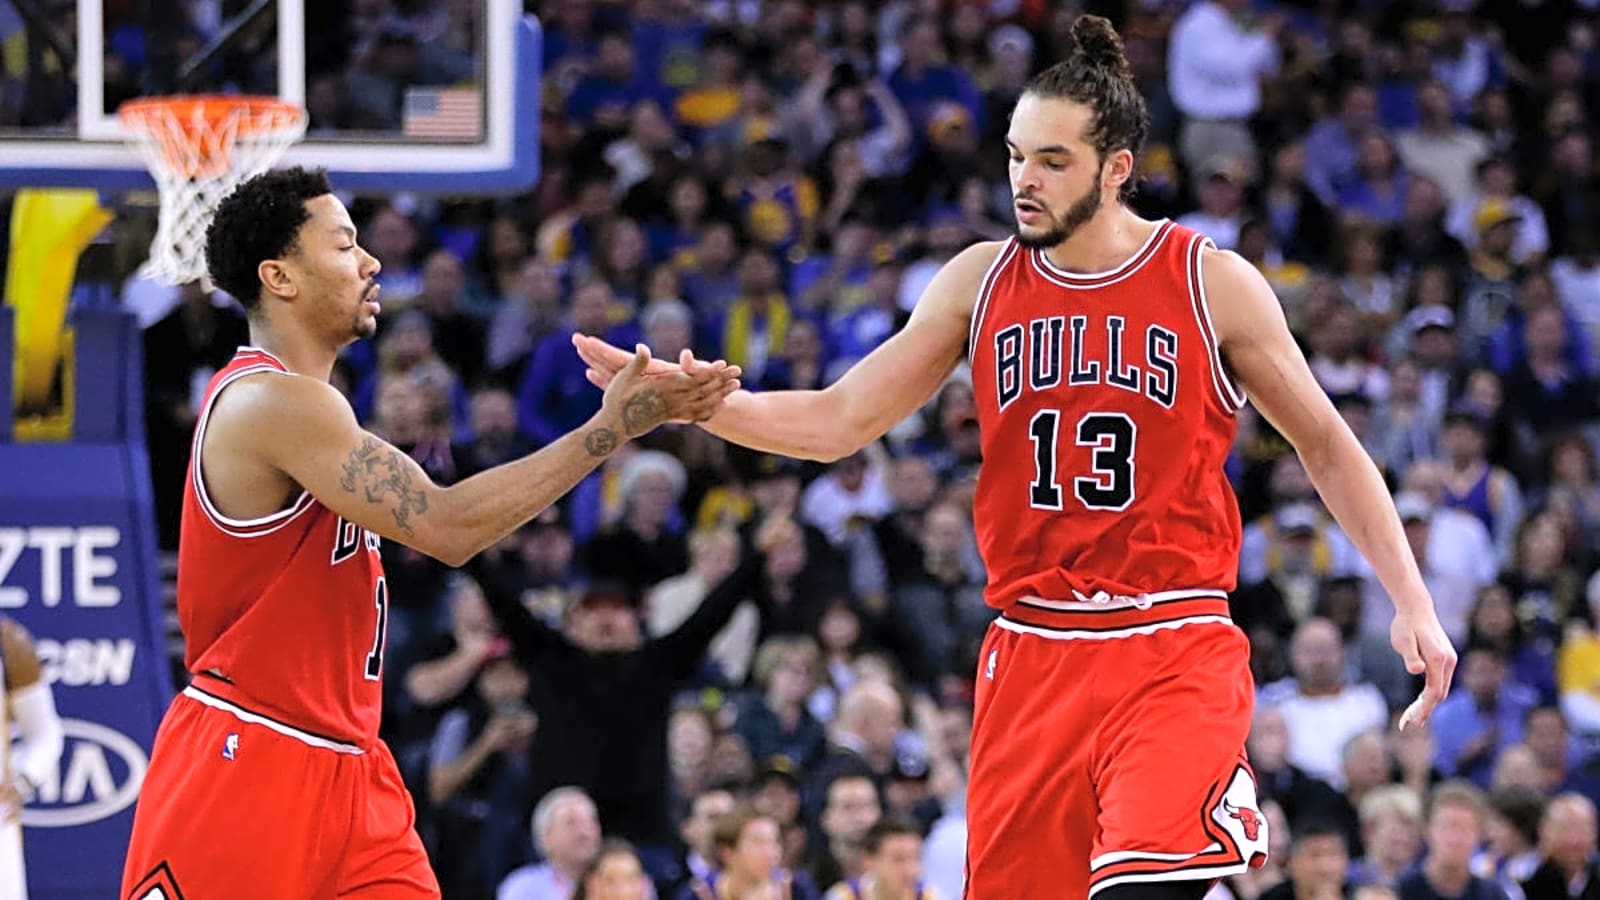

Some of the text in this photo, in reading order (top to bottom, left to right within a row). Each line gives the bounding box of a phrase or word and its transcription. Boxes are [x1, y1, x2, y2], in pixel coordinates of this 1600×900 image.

[994, 315, 1178, 412] BULLS
[1029, 409, 1137, 511] 13
[0, 526, 121, 607] ZTE
[364, 576, 388, 680] 1
